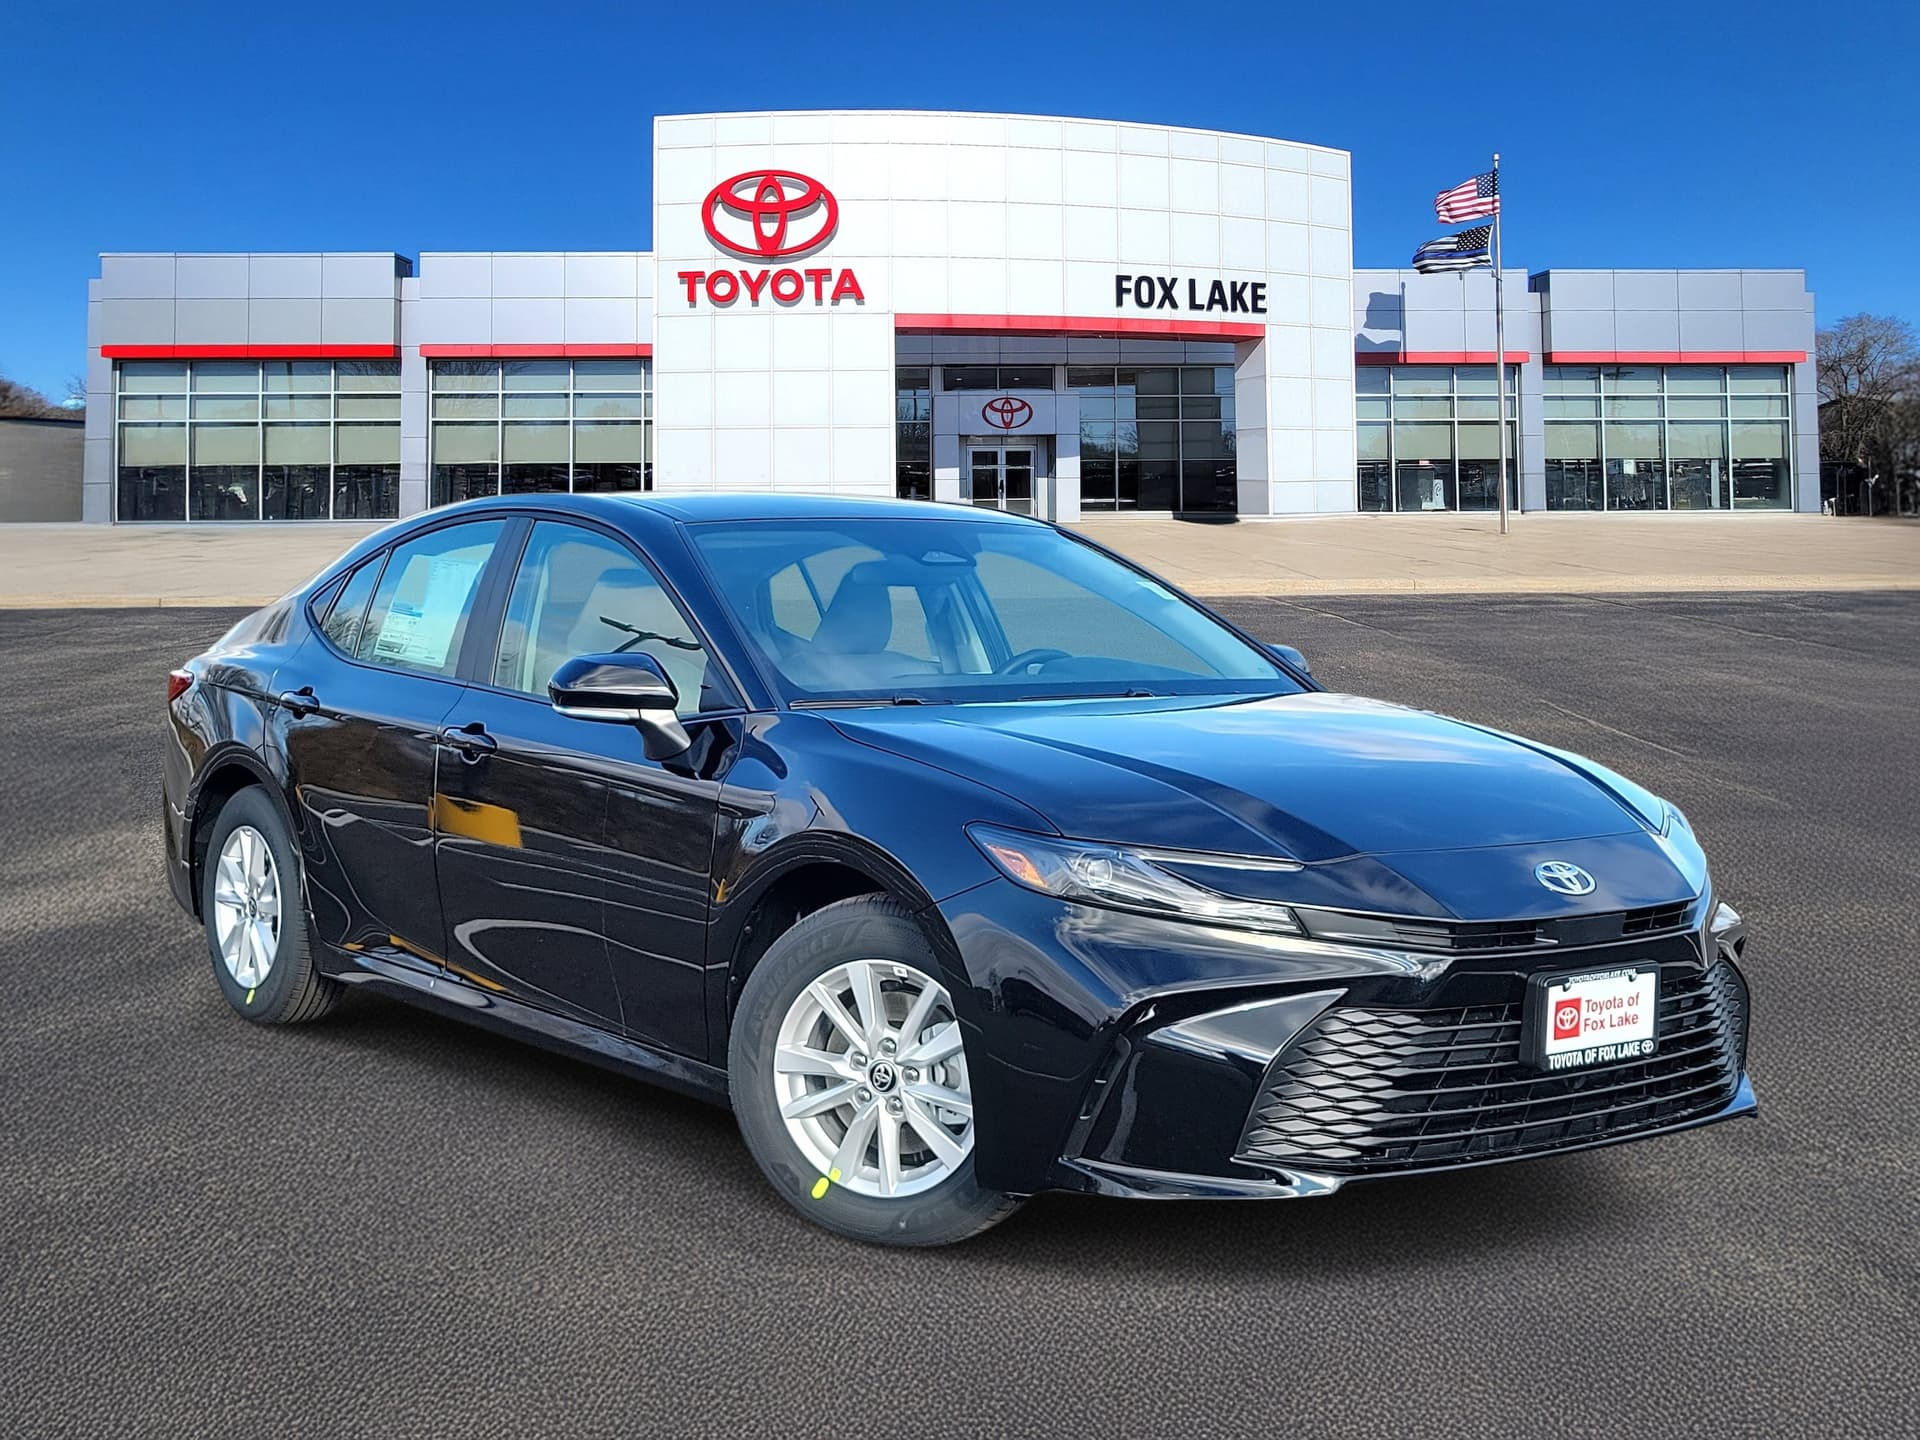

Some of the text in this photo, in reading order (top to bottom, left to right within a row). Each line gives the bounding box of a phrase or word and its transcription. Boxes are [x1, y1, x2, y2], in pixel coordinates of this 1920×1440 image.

[677, 268, 865, 304] TOYOTA
[1115, 274, 1268, 314] FOX LAKE
[1585, 992, 1640, 1015] Toyota of
[1584, 1012, 1639, 1032] Fox Lake
[1548, 1041, 1640, 1070] TOYOTA OF FOX LAKE
